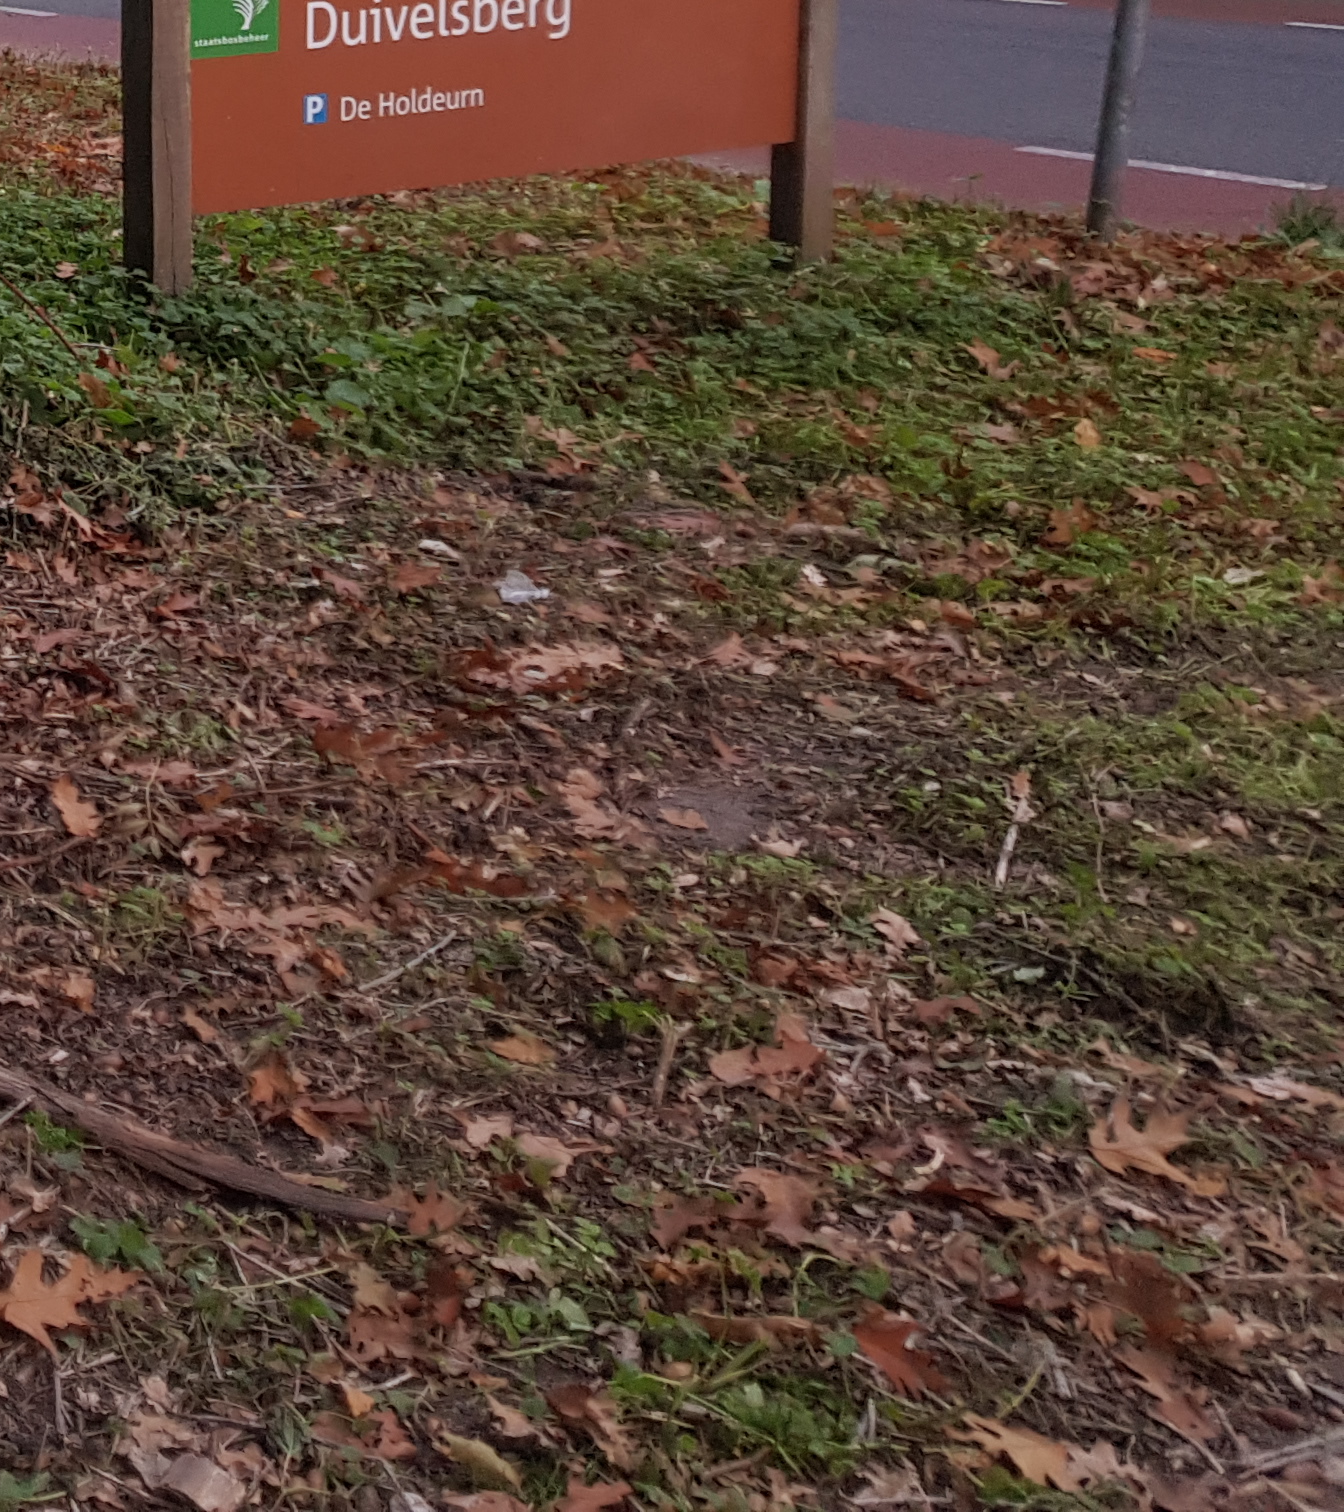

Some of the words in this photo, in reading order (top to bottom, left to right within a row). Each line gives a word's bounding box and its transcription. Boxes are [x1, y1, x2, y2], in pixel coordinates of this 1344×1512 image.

[194, 33, 269, 48] staatsbosbeheer
[306, 96, 324, 123] P
[340, 96, 371, 122] De
[379, 87, 485, 118] Holdeurn
